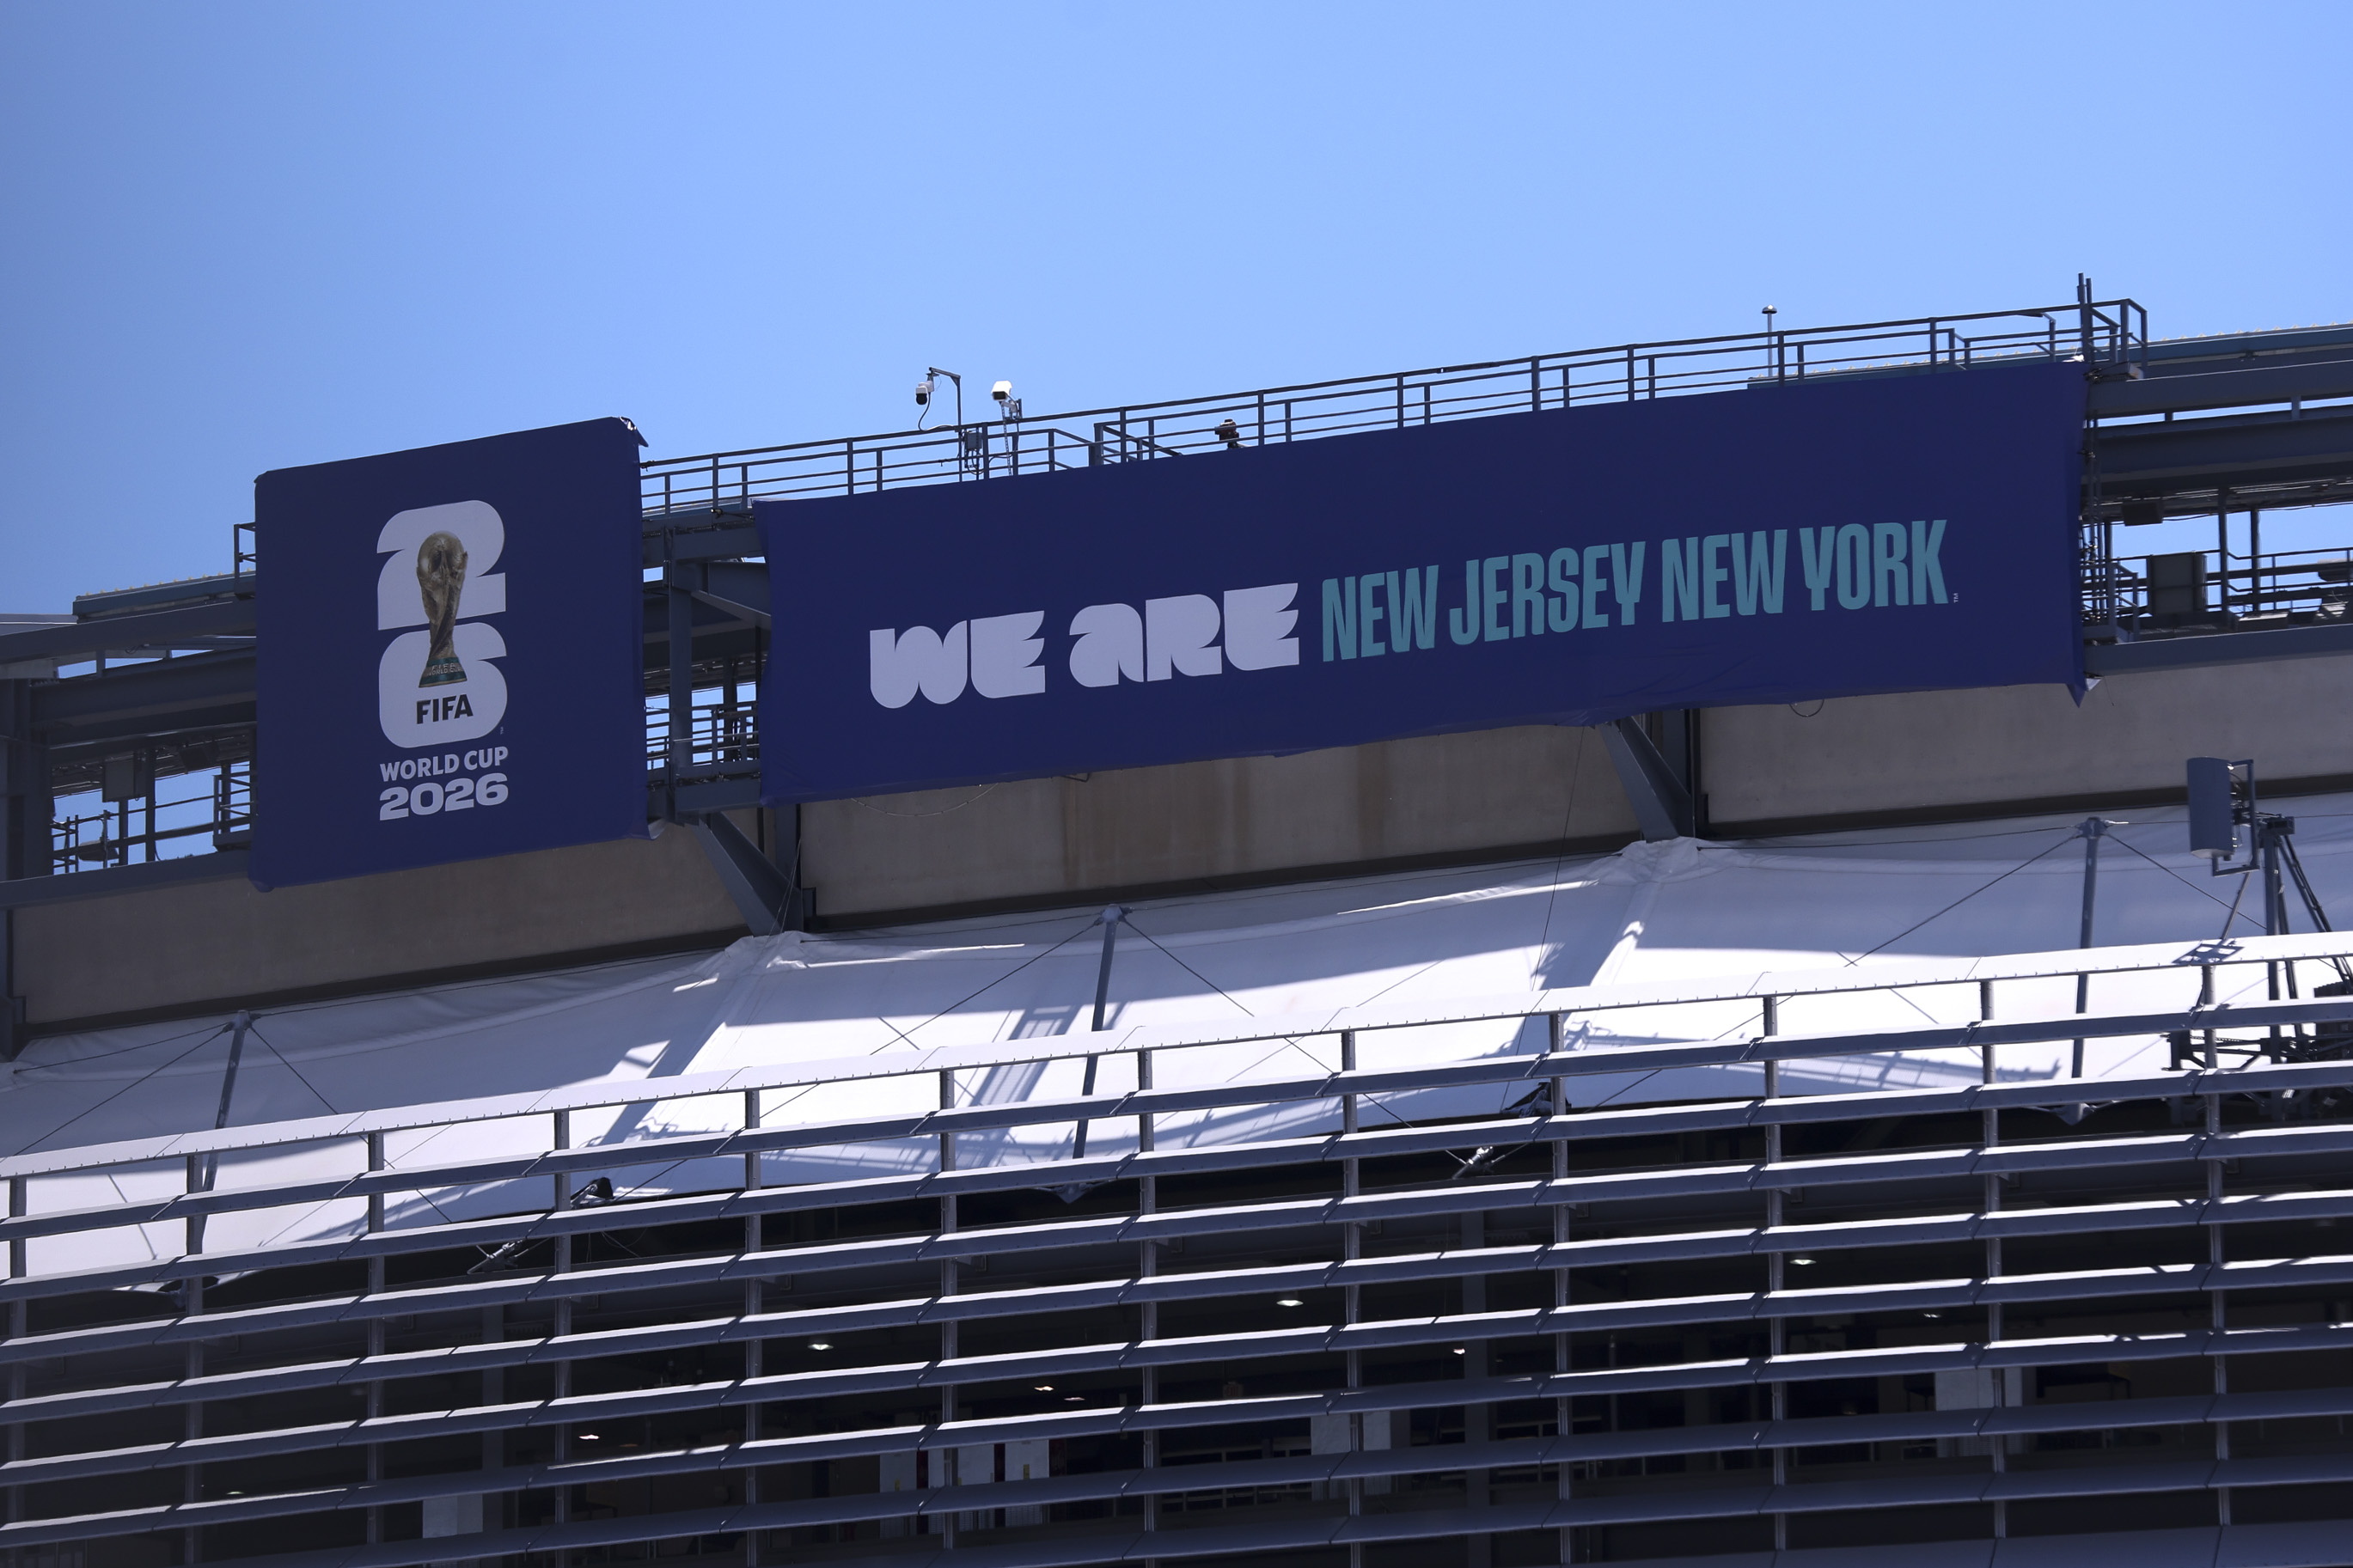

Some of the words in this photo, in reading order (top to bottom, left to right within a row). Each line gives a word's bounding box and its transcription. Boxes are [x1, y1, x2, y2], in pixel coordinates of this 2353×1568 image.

[870, 611, 1045, 709] WE
[1069, 583, 1299, 687] ARE
[1323, 565, 1439, 662] NEW
[1450, 541, 1646, 644] JERSEY
[1662, 529, 1788, 622] NEW
[1800, 520, 1948, 610] YORK
[431, 662, 456, 671] FIFA
[416, 694, 473, 724] FIFA
[380, 754, 459, 782] WORLD
[464, 747, 508, 771] CUP
[380, 773, 508, 821] 2026
